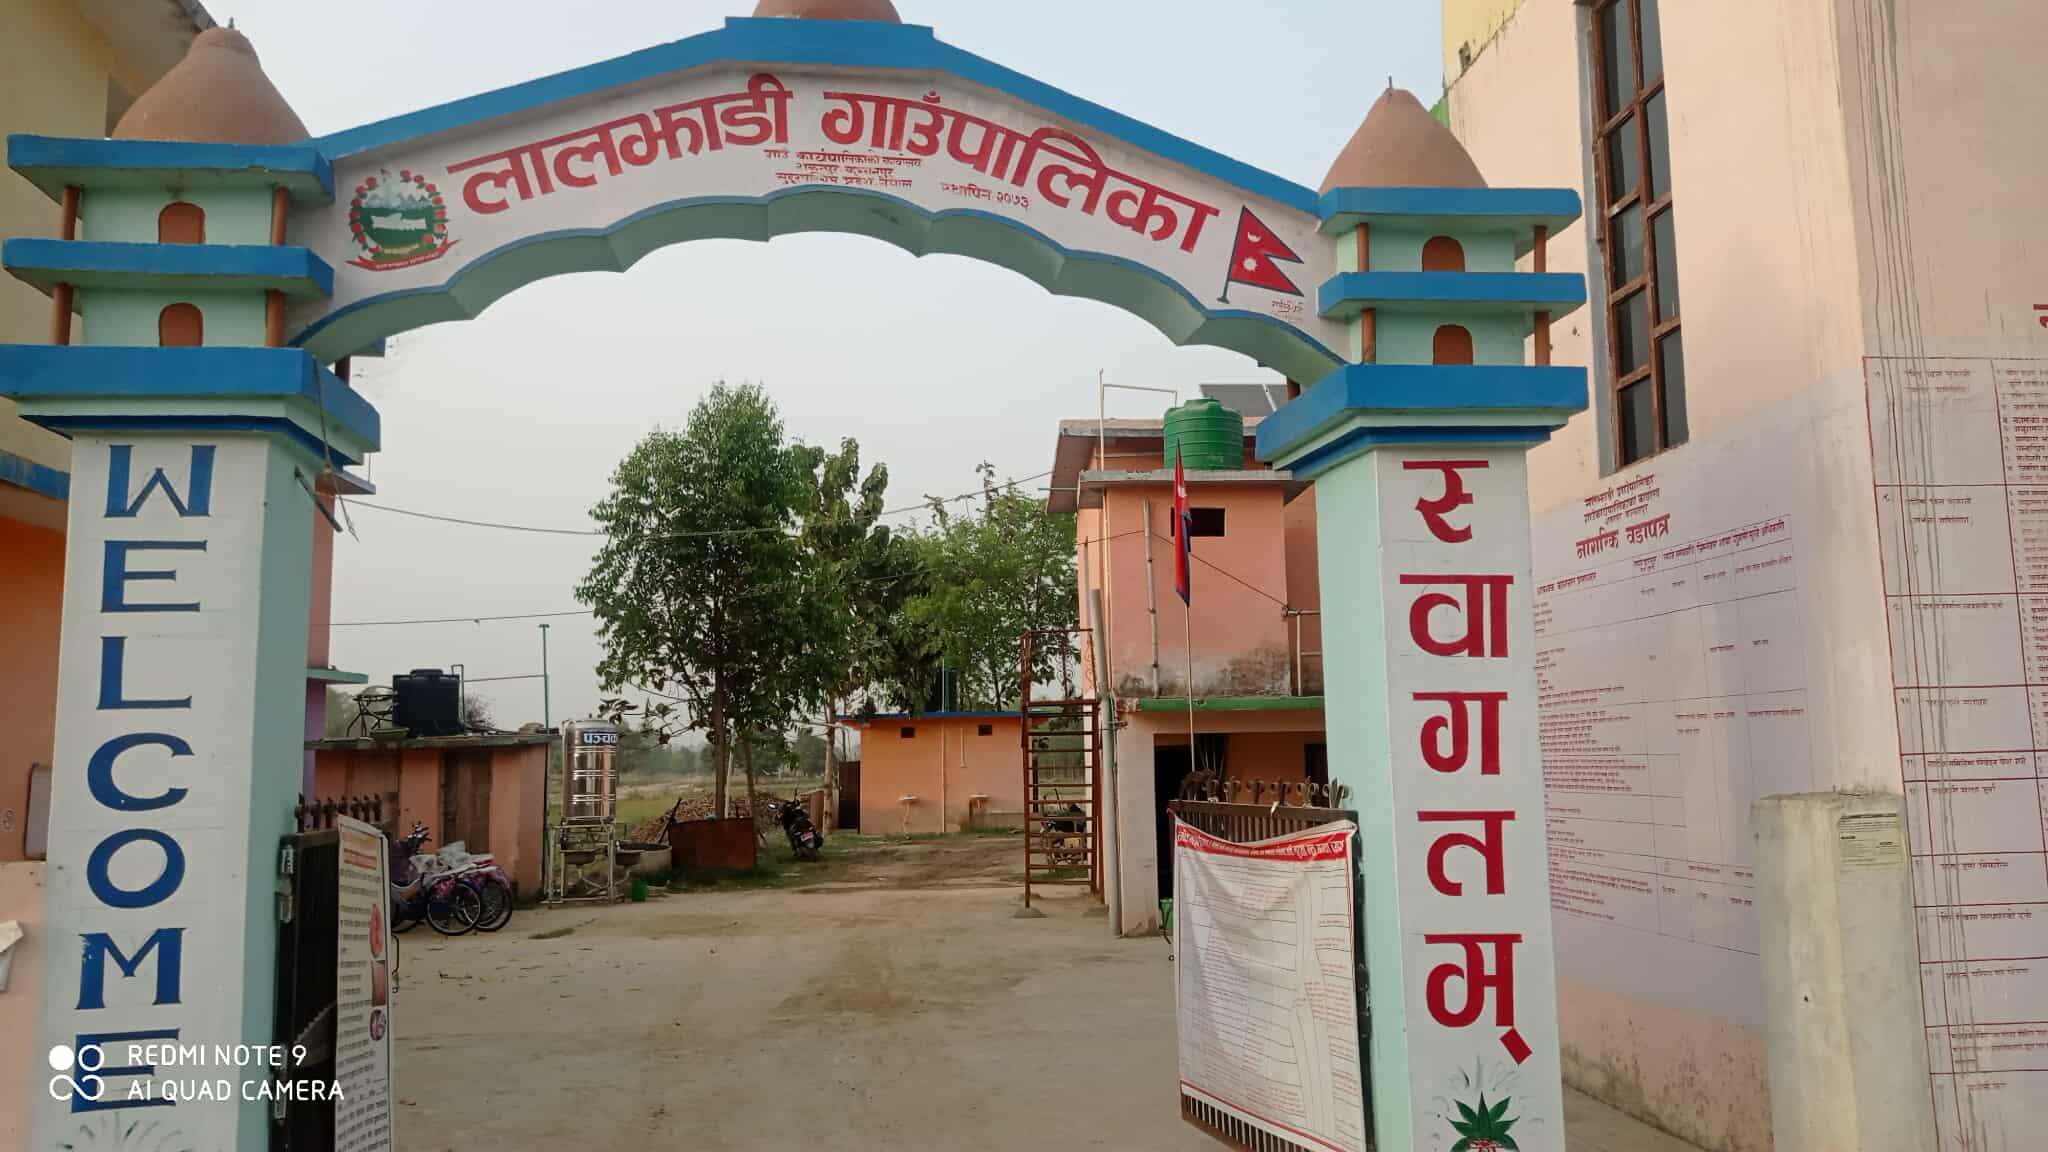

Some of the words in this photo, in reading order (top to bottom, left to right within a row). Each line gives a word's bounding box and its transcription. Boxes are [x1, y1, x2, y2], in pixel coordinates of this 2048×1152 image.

[446, 72, 793, 215] लालझाडी
[820, 90, 1221, 253] गाउँपालिका
[1576, 525, 1619, 560] नागरिक
[1625, 512, 1671, 546] वडापत्र
[71, 444, 216, 1114] WELCOME
